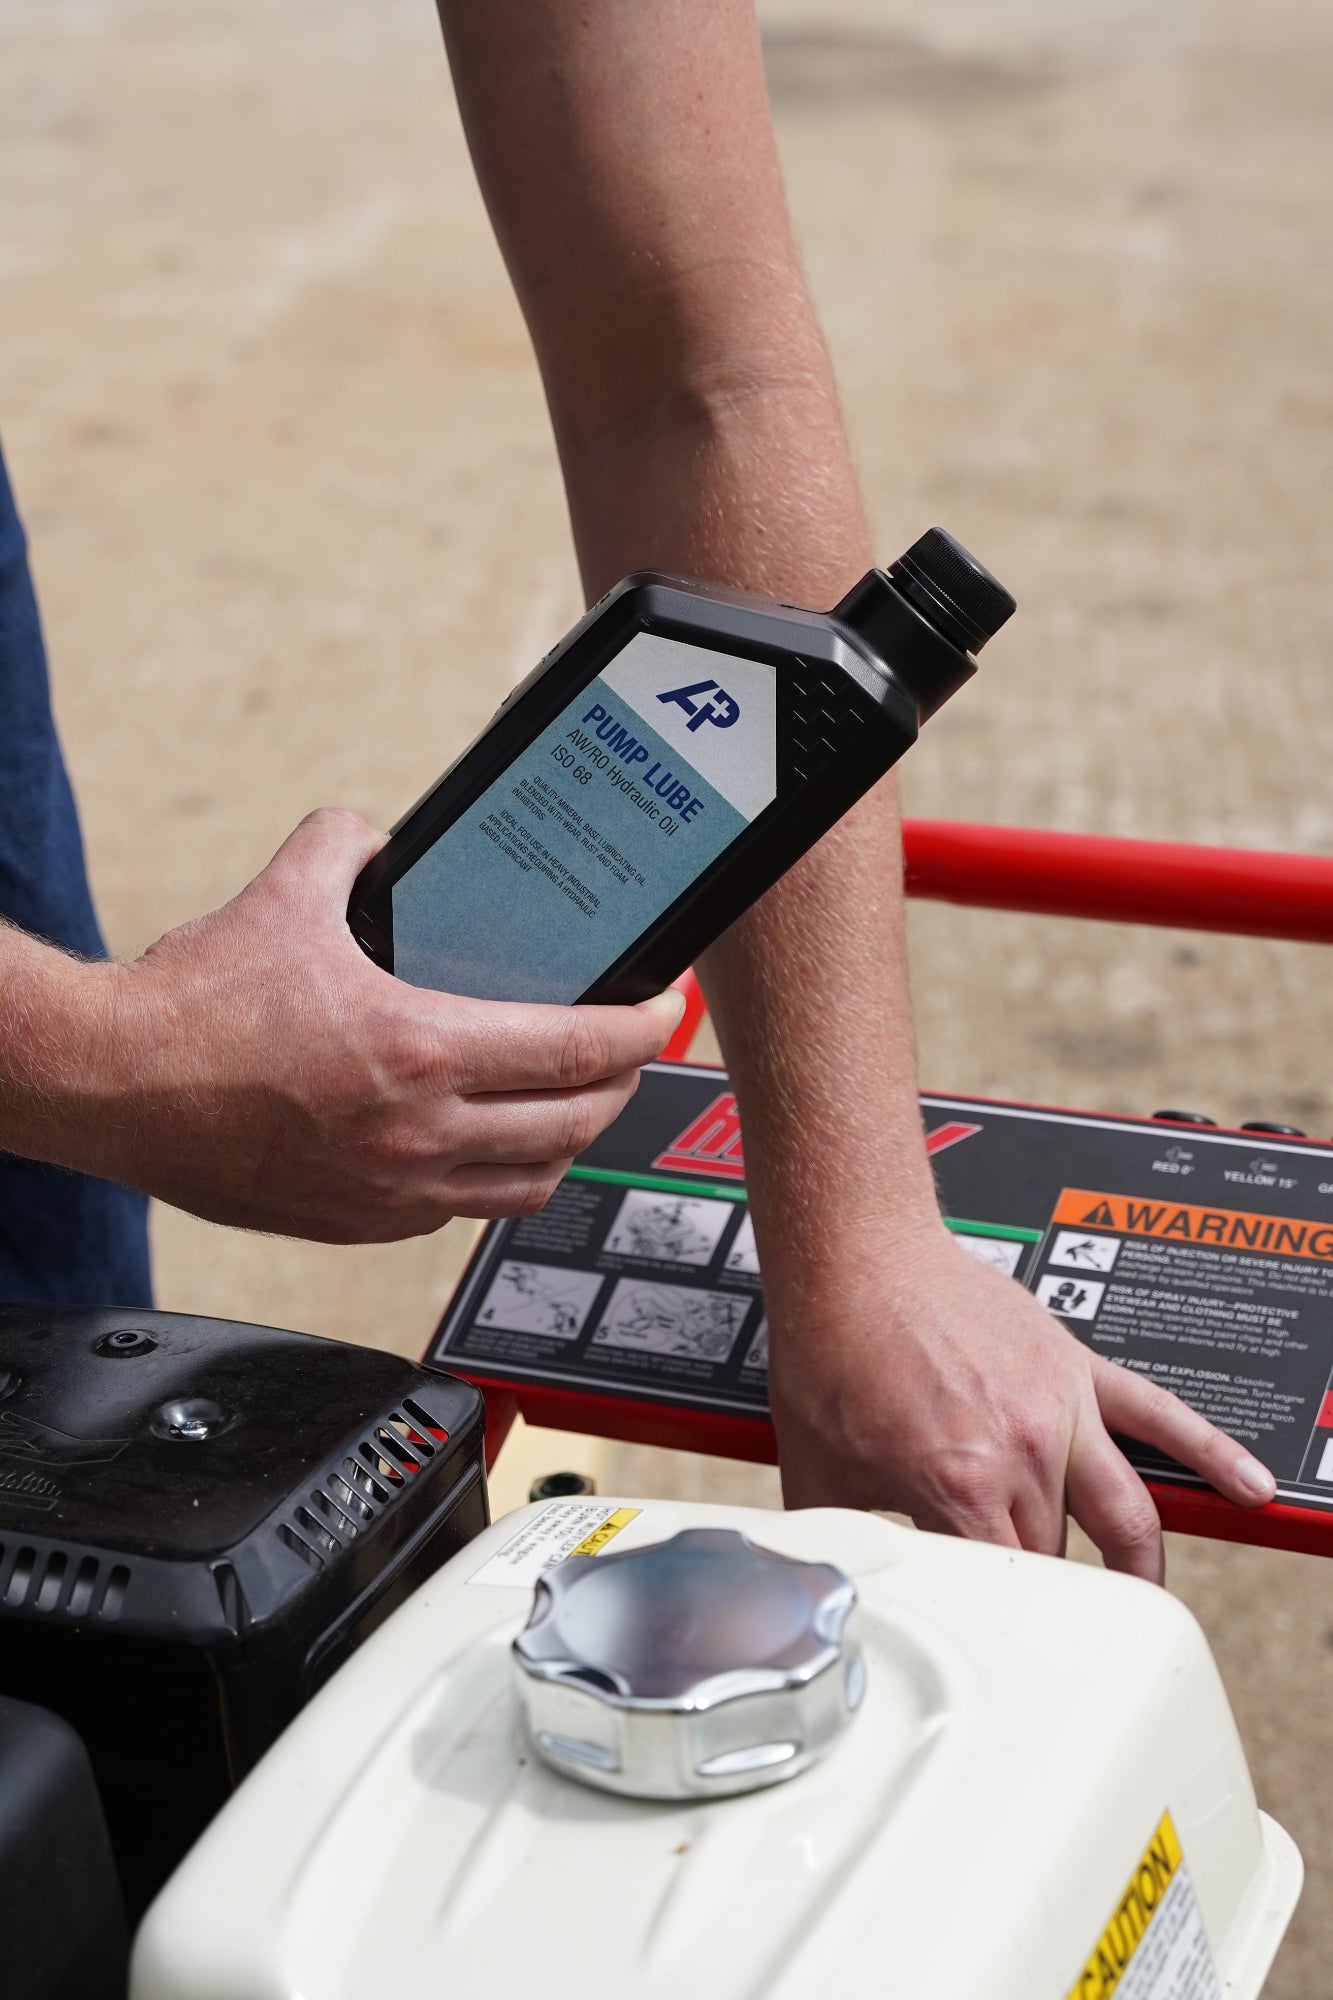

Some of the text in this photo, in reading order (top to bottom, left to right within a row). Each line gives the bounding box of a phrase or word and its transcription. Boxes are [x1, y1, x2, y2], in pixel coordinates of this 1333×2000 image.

[550, 744, 593, 785] ISO 68
[581, 703, 705, 824] PUMP LUBE
[565, 728, 679, 837] AW/RO Hydraulic Oil
[511, 787, 546, 821] INHIBITORS
[478, 821, 533, 873] BASED LUBRICANT
[519, 779, 629, 885] BLENDED WITH WEAR, RUST AND FOAM
[533, 775, 646, 887] QUALITY MINERAL BASE LUBRICATING OIL
[486, 814, 596, 918] APPLICATIONS REQUIRING A HYDRAULIC
[500, 809, 601, 909] IDEAL FOR USE IN HEAVY INDUSTRIAL
[1152, 1160, 1180, 1173] RED
[1224, 1170, 1277, 1186] YELLOW
[1125, 1202, 1333, 1257] WARNING
[731, 1253, 743, 1266] 2
[1124, 1240, 1149, 1251] RISK
[1150, 1244, 1166, 1253] OF
[1221, 1254, 1238, 1263] OR
[1238, 1256, 1280, 1270] SEVERE
[1281, 1262, 1320, 1275] INJURY
[1103, 1302, 1136, 1315] WORN
[1105, 1293, 1283, 1327] EYEWEAR AND CLOTHING MUST BE
[1109, 1284, 1134, 1295] RISK
[1134, 1287, 1151, 1297] OF
[1151, 1289, 1187, 1302] SPRAY
[1111, 1356, 1127, 1365] OF
[1127, 1359, 1152, 1370] FIRE
[1152, 1363, 1169, 1373] OR
[1234, 1375, 1276, 1389] Gasoline
[570, 1507, 598, 1525] BURN
[595, 1507, 611, 1521] HOT
[559, 1522, 597, 1552] MUFFLER
[578, 1530, 609, 1557] CAUT
